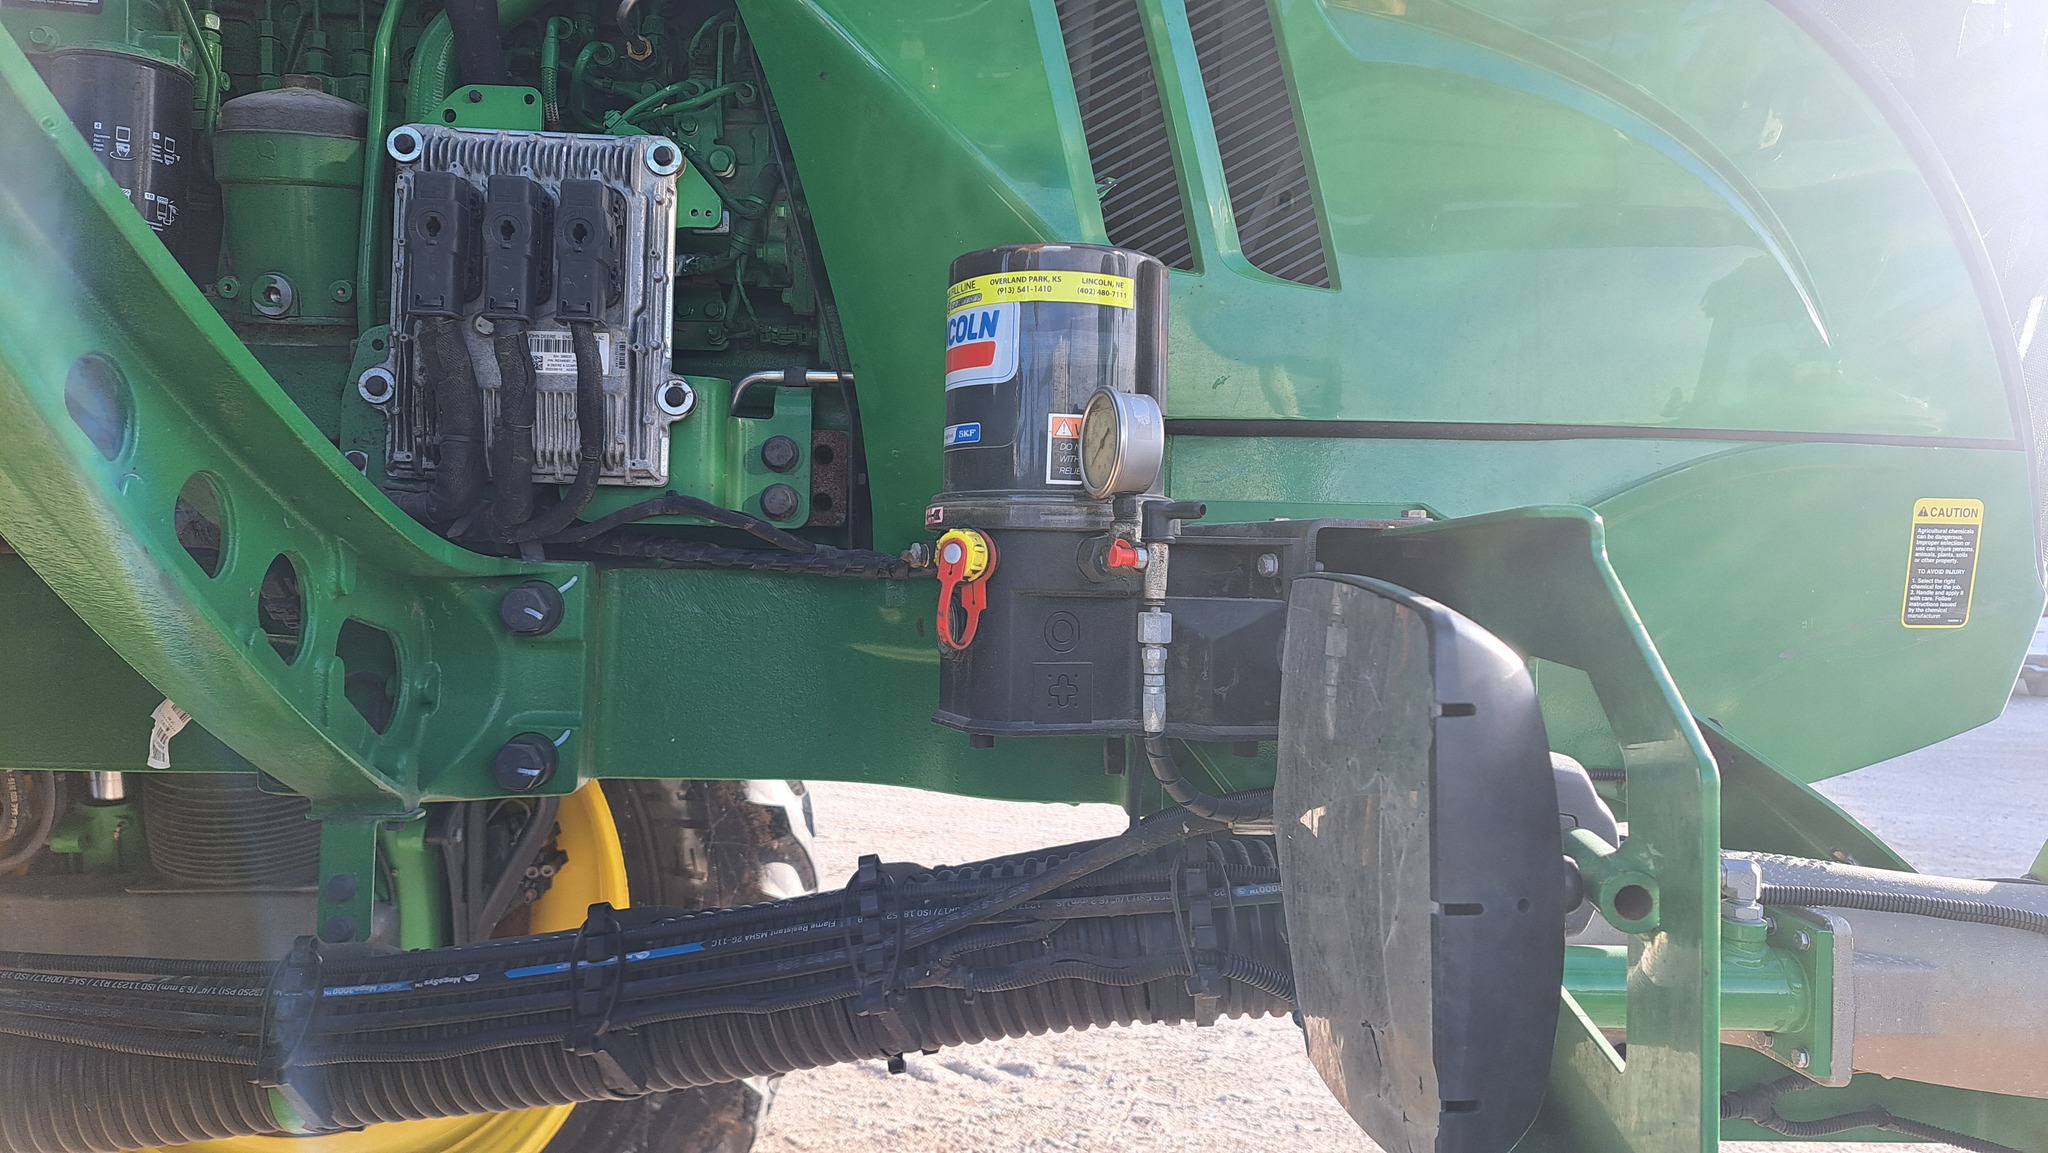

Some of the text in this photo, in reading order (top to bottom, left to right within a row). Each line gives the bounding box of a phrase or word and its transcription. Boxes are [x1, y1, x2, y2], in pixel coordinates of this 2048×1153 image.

[990, 275, 1062, 286] OVERLAND PARK, KS
[1082, 277, 1124, 289] LINCOLN, NE
[997, 285, 1053, 296] (913) 541-1410
[1077, 287, 1127, 299] (402) 480-7111
[947, 310, 1000, 347] COLN
[958, 428, 977, 438] SKF
[1060, 442, 1073, 451] DO
[1060, 455, 1079, 463] WITH
[1059, 466, 1081, 475] RELIE
[1930, 506, 1979, 518] CAUTION
[1917, 527, 1948, 535] Agricultural
[711, 920, 837, 947] Flame Resistant MSHA 2G-11C
[14, 972, 30, 981] ISO
[70, 976, 88, 986] SAE
[92, 979, 112, 988] R17
[112, 980, 141, 990] 11237
[141, 982, 156, 991] ISO
[156, 983, 179, 992] mm)
[218, 987, 238, 997] PSI)
